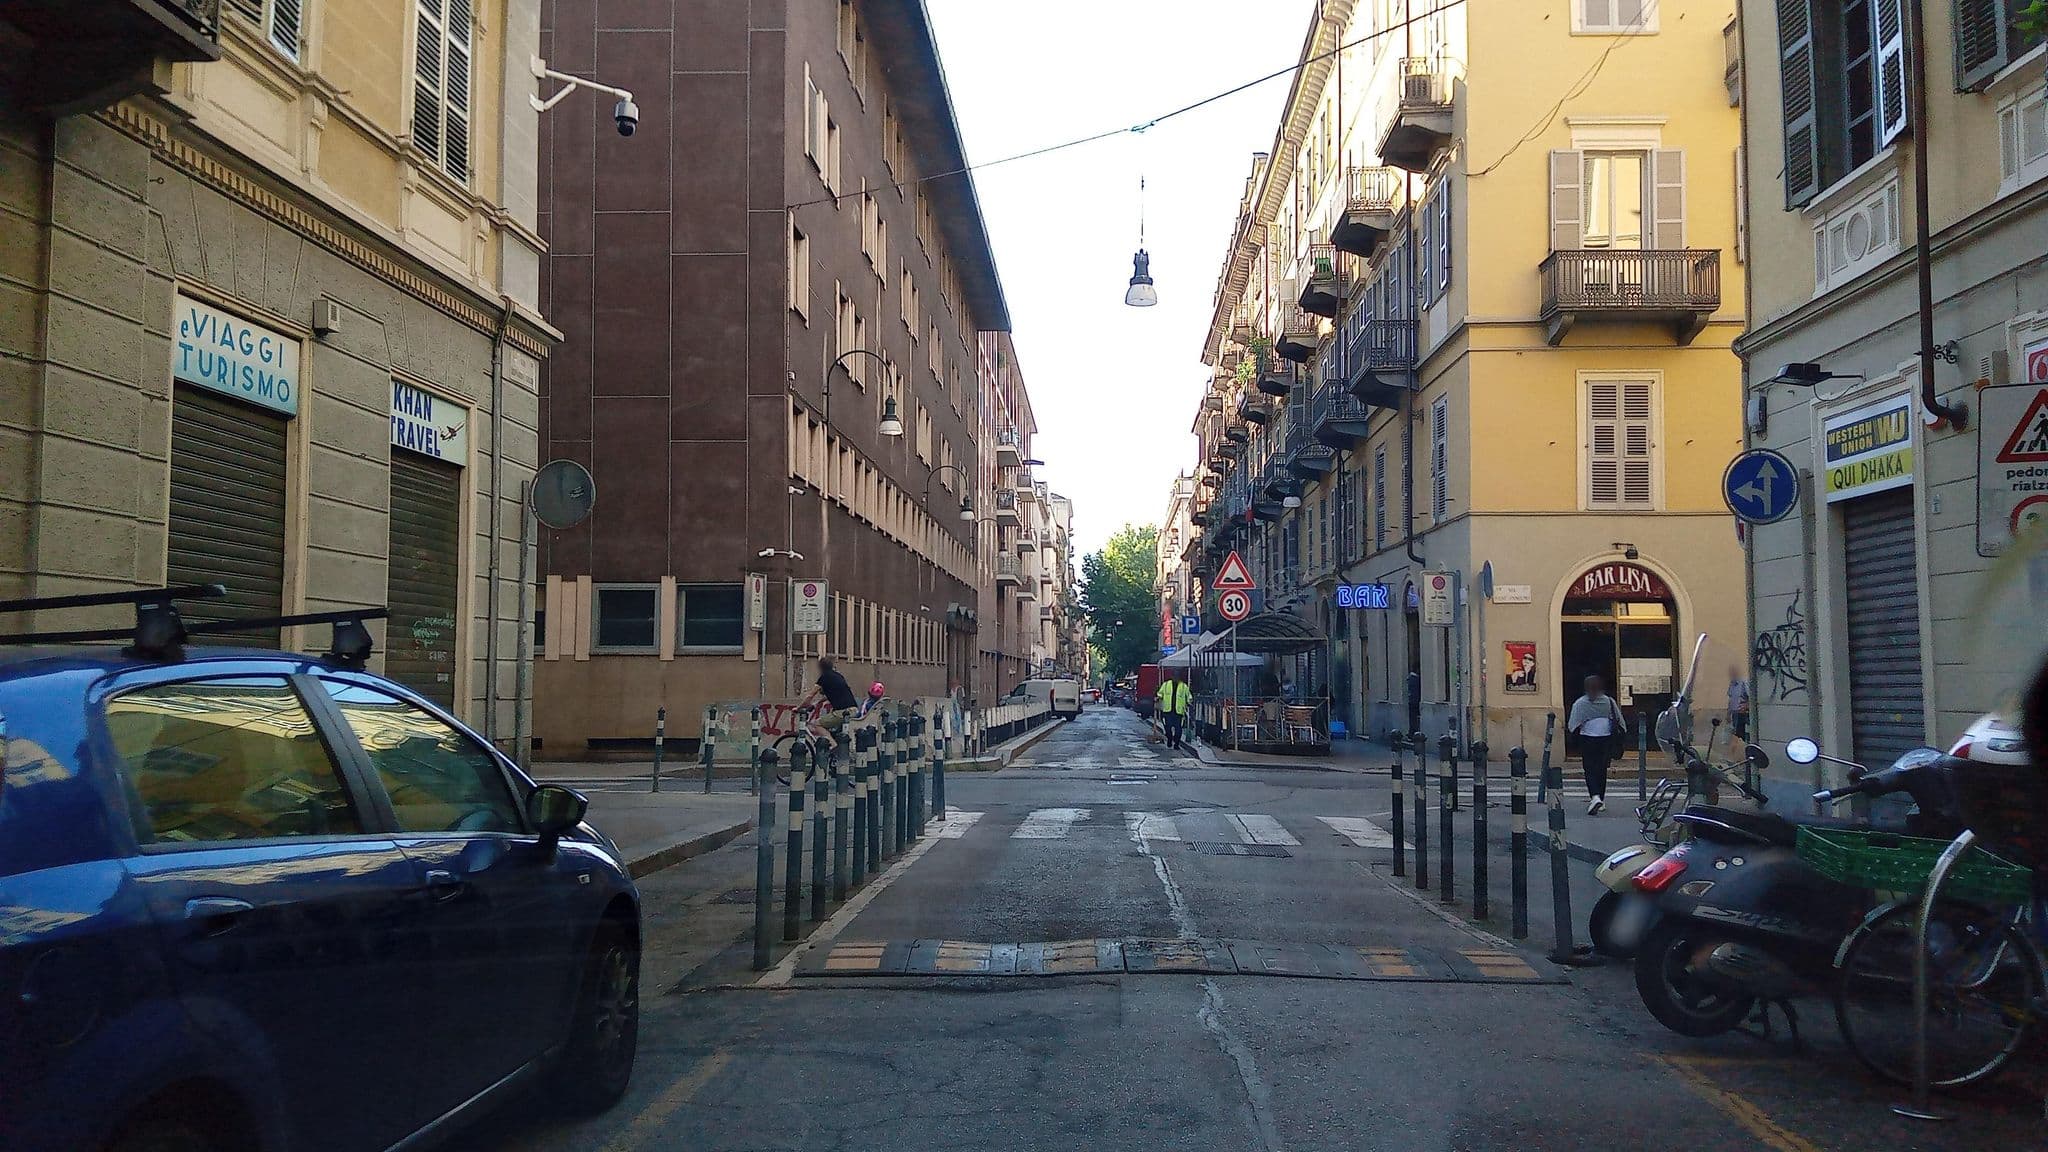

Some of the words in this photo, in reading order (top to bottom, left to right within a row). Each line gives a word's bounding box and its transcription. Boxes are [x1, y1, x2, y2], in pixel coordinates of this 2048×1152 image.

[178, 341, 290, 403] TURISMO
[393, 382, 432, 423] KHAN
[391, 415, 441, 457] TRAVEL
[1827, 421, 1873, 446] WESTERN
[1841, 435, 1873, 456] UNION
[1833, 465, 1856, 490] QUI
[1861, 452, 1904, 484] DHAKA
[1584, 565, 1616, 594] BAR
[1619, 565, 1652, 594] LISA
[1226, 598, 1243, 612] 30
[1337, 585, 1389, 609] BAR
[1185, 617, 1198, 633] P
